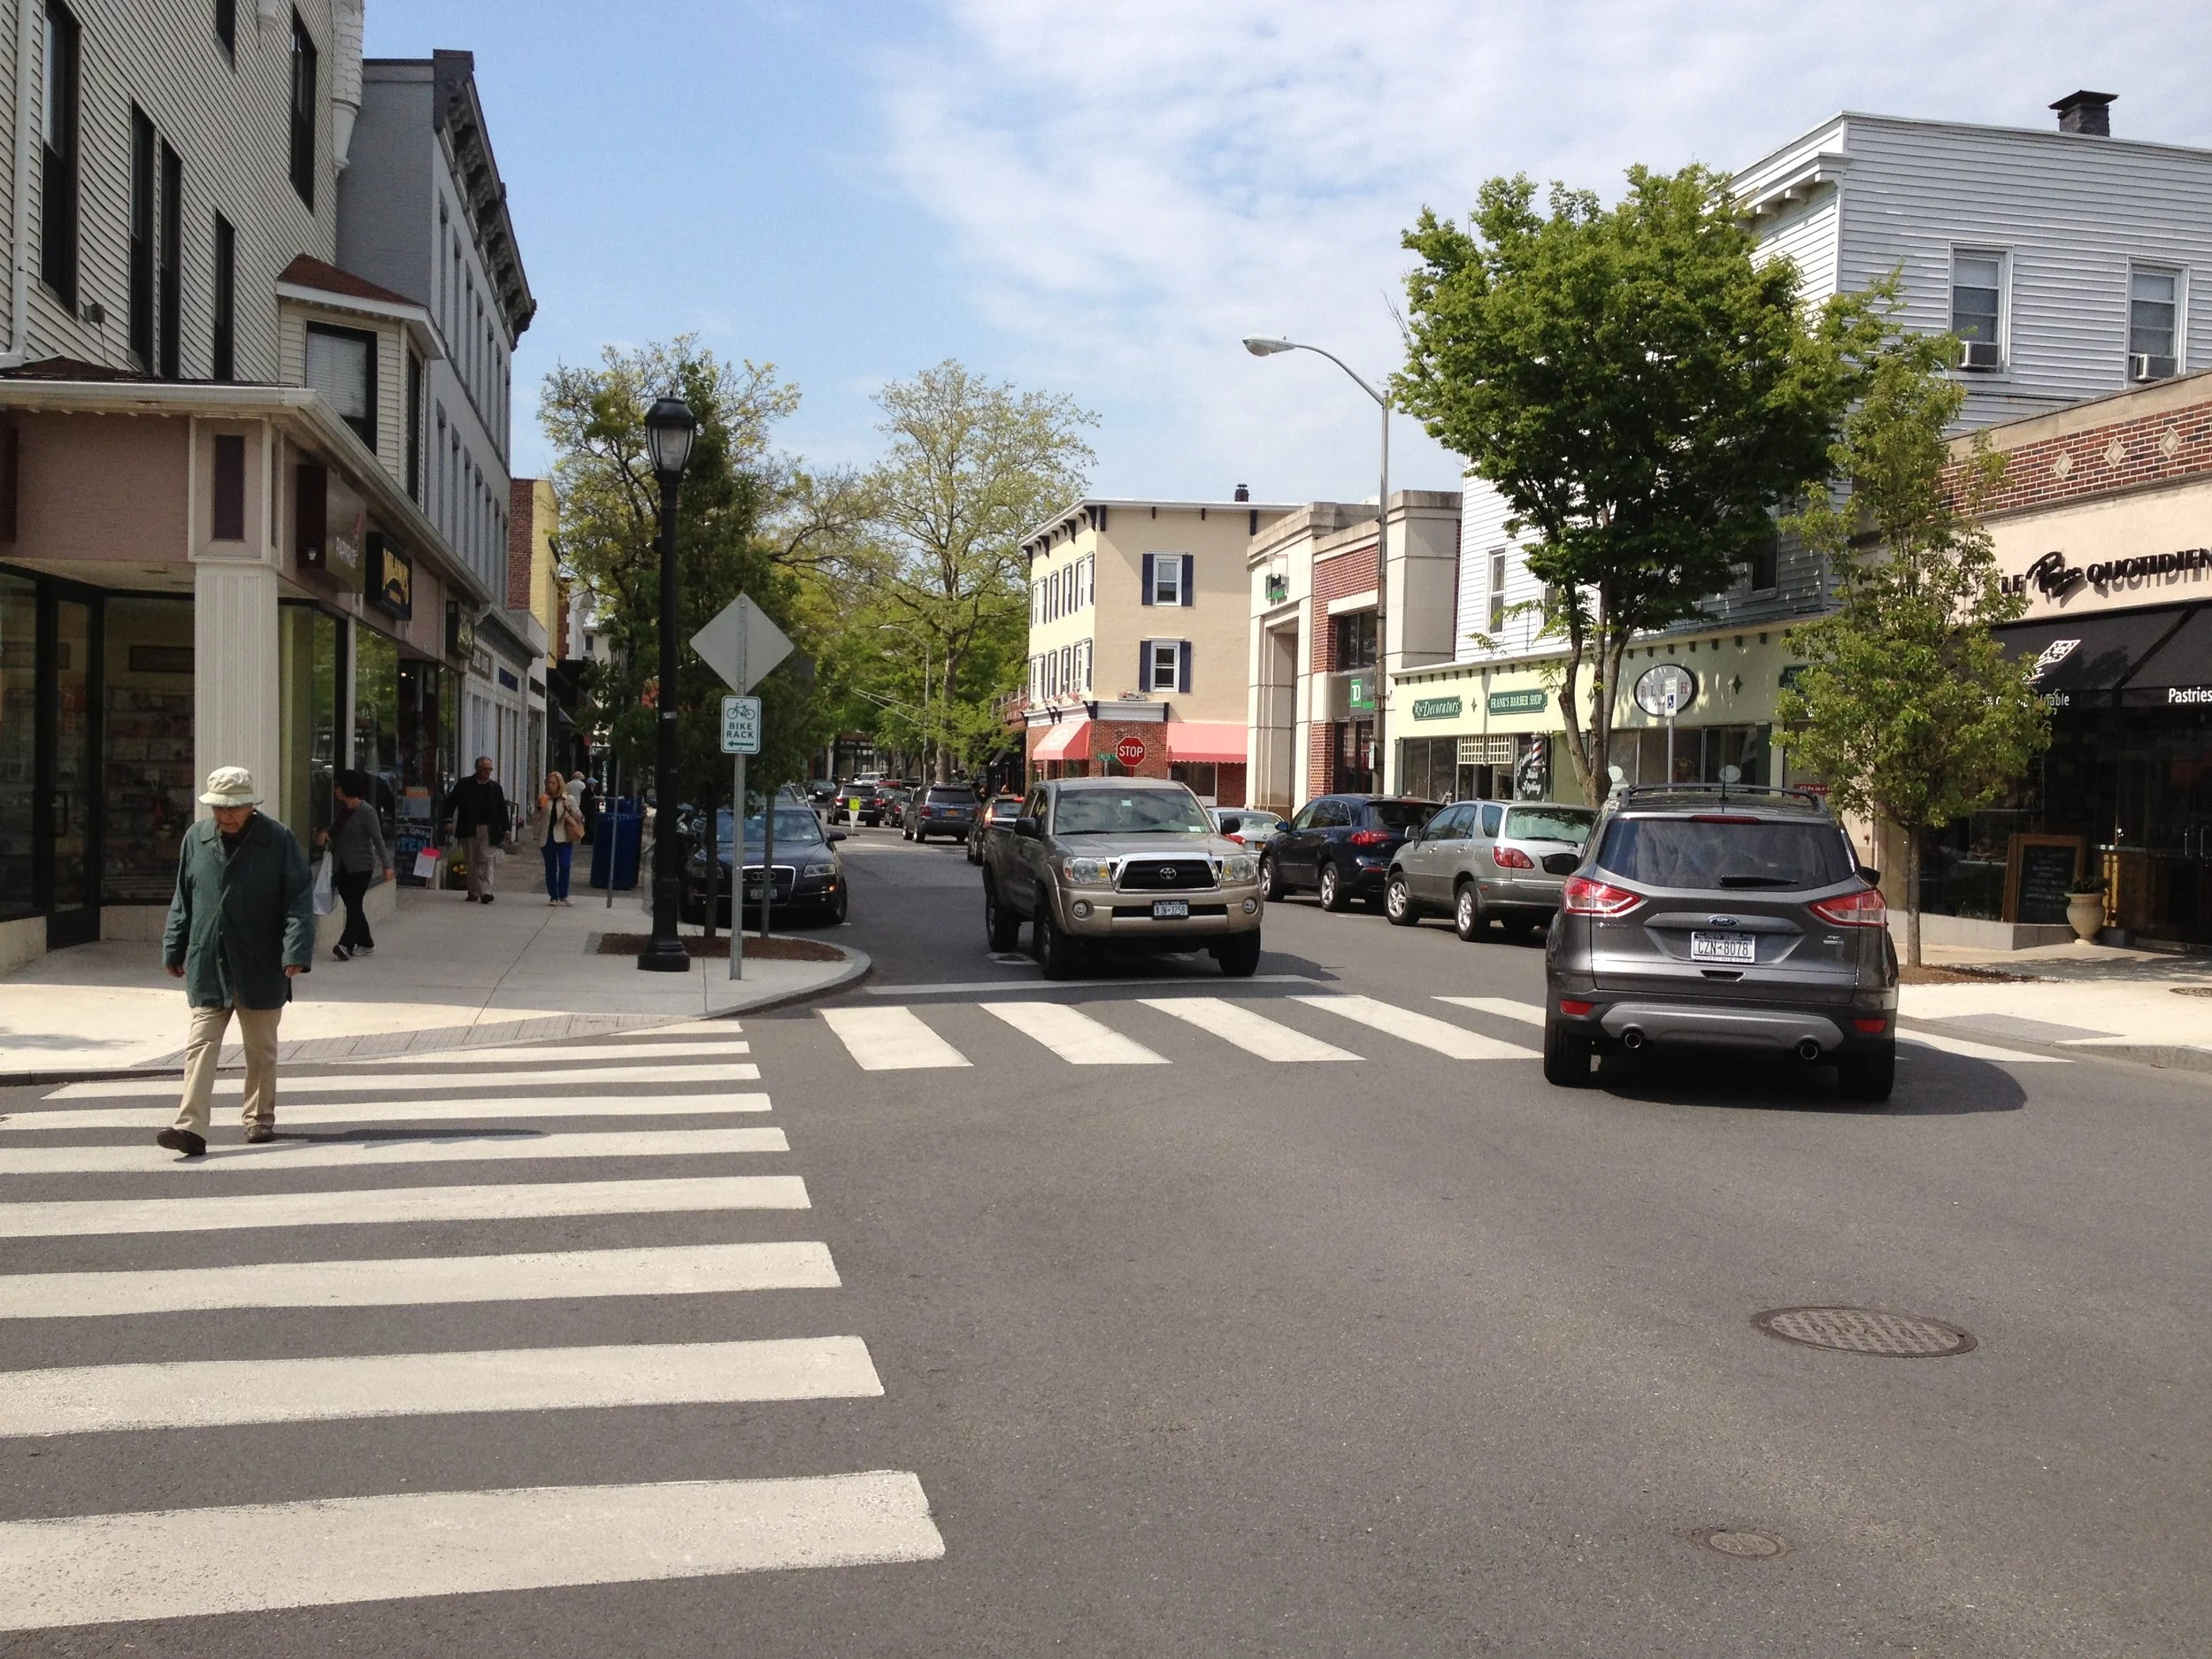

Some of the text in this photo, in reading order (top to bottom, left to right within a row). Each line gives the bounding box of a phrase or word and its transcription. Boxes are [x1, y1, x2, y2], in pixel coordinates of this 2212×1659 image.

[2001, 574, 2024, 594] LE
[1641, 681, 1688, 697] BLUH
[2169, 686, 2212, 703] Pastries
[1509, 695, 1529, 707] BARBER
[1530, 694, 1543, 706] SHOP
[1424, 701, 1460, 717] Decorators
[729, 722, 752, 731] BIKE
[726, 730, 754, 739] RACK
[1118, 745, 1143, 758] STOP
